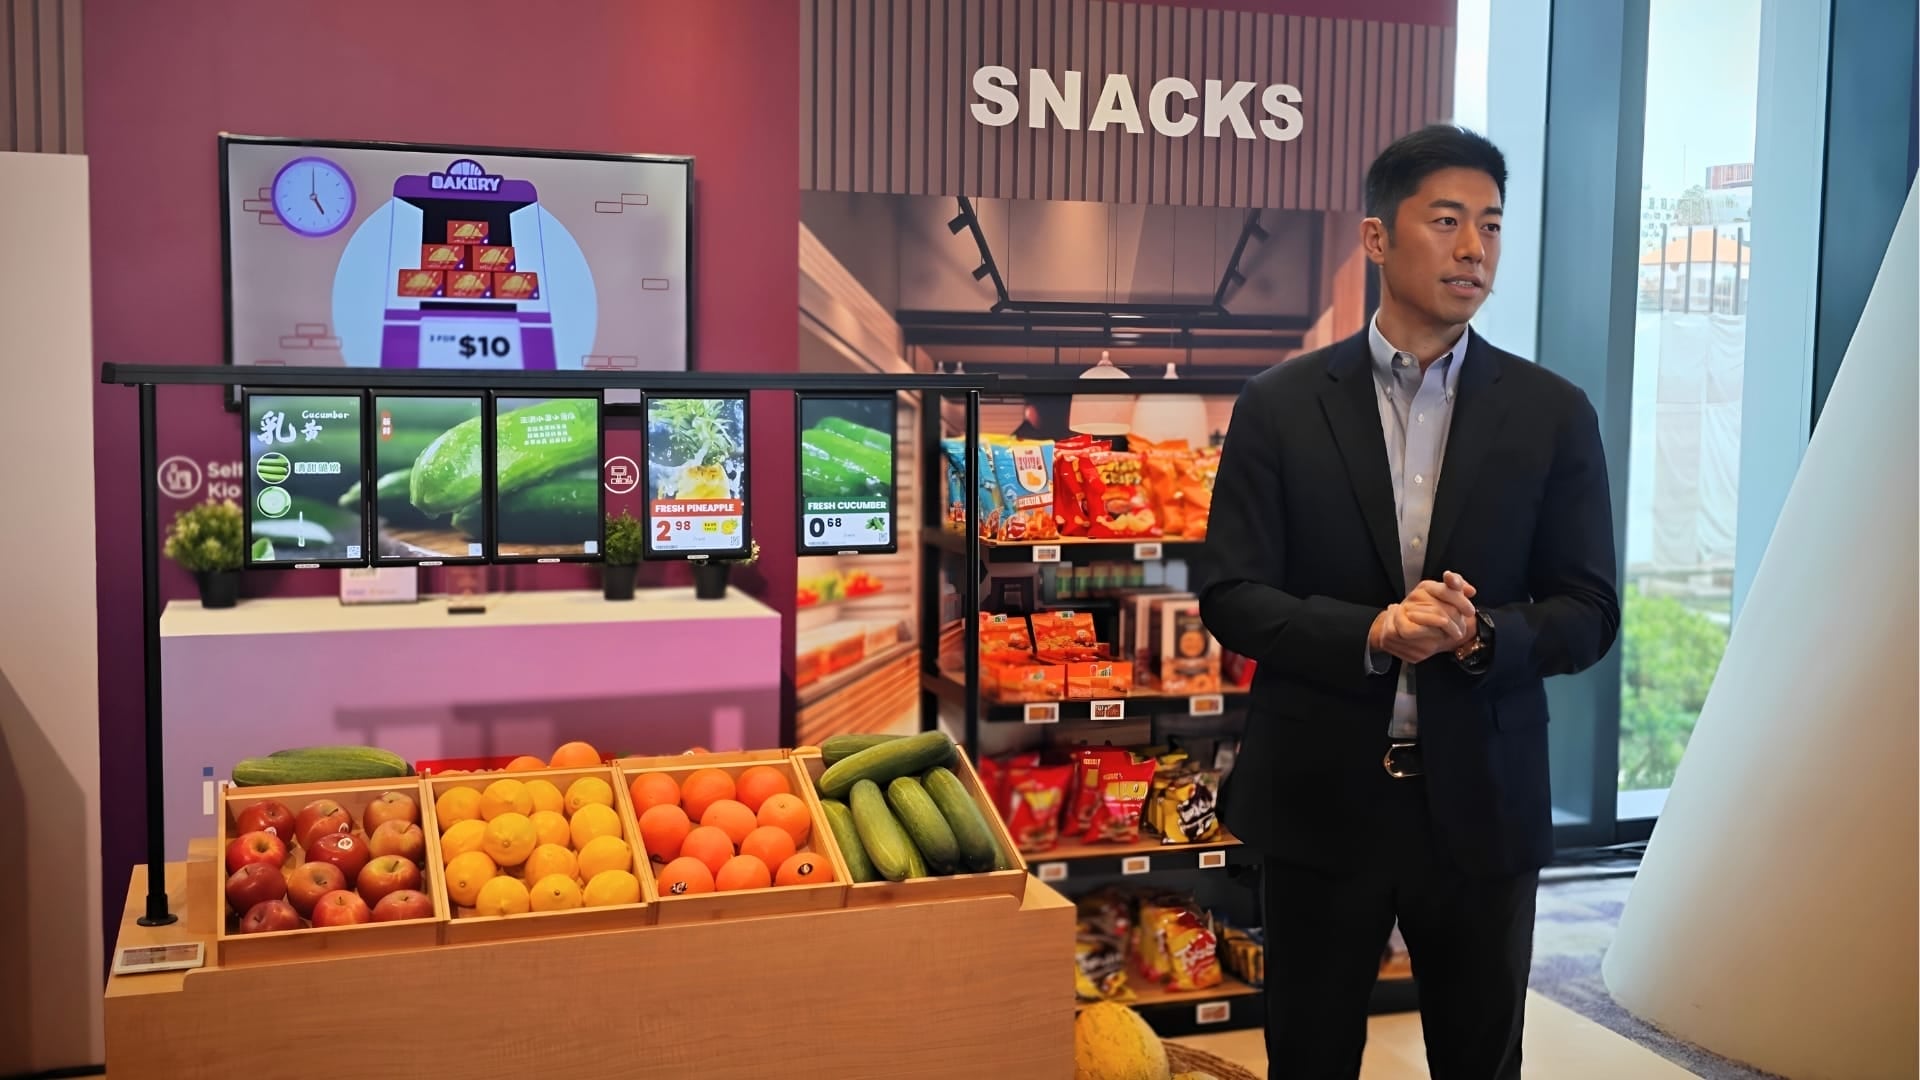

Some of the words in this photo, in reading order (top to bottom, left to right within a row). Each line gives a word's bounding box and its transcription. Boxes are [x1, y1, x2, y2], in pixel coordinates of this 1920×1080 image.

[970, 65, 1304, 142] SNACKS
[431, 175, 500, 192] BAKERY
[458, 334, 511, 359] $10
[301, 410, 350, 419] Cucumber
[655, 503, 685, 513] FRESH
[686, 503, 735, 512] PINEAPPLE
[807, 501, 836, 511] FRESH
[837, 501, 887, 510] CUCUMBER
[656, 520, 672, 541] 2
[675, 520, 692, 531] 98
[809, 517, 826, 538] 0
[827, 517, 842, 528] 68
